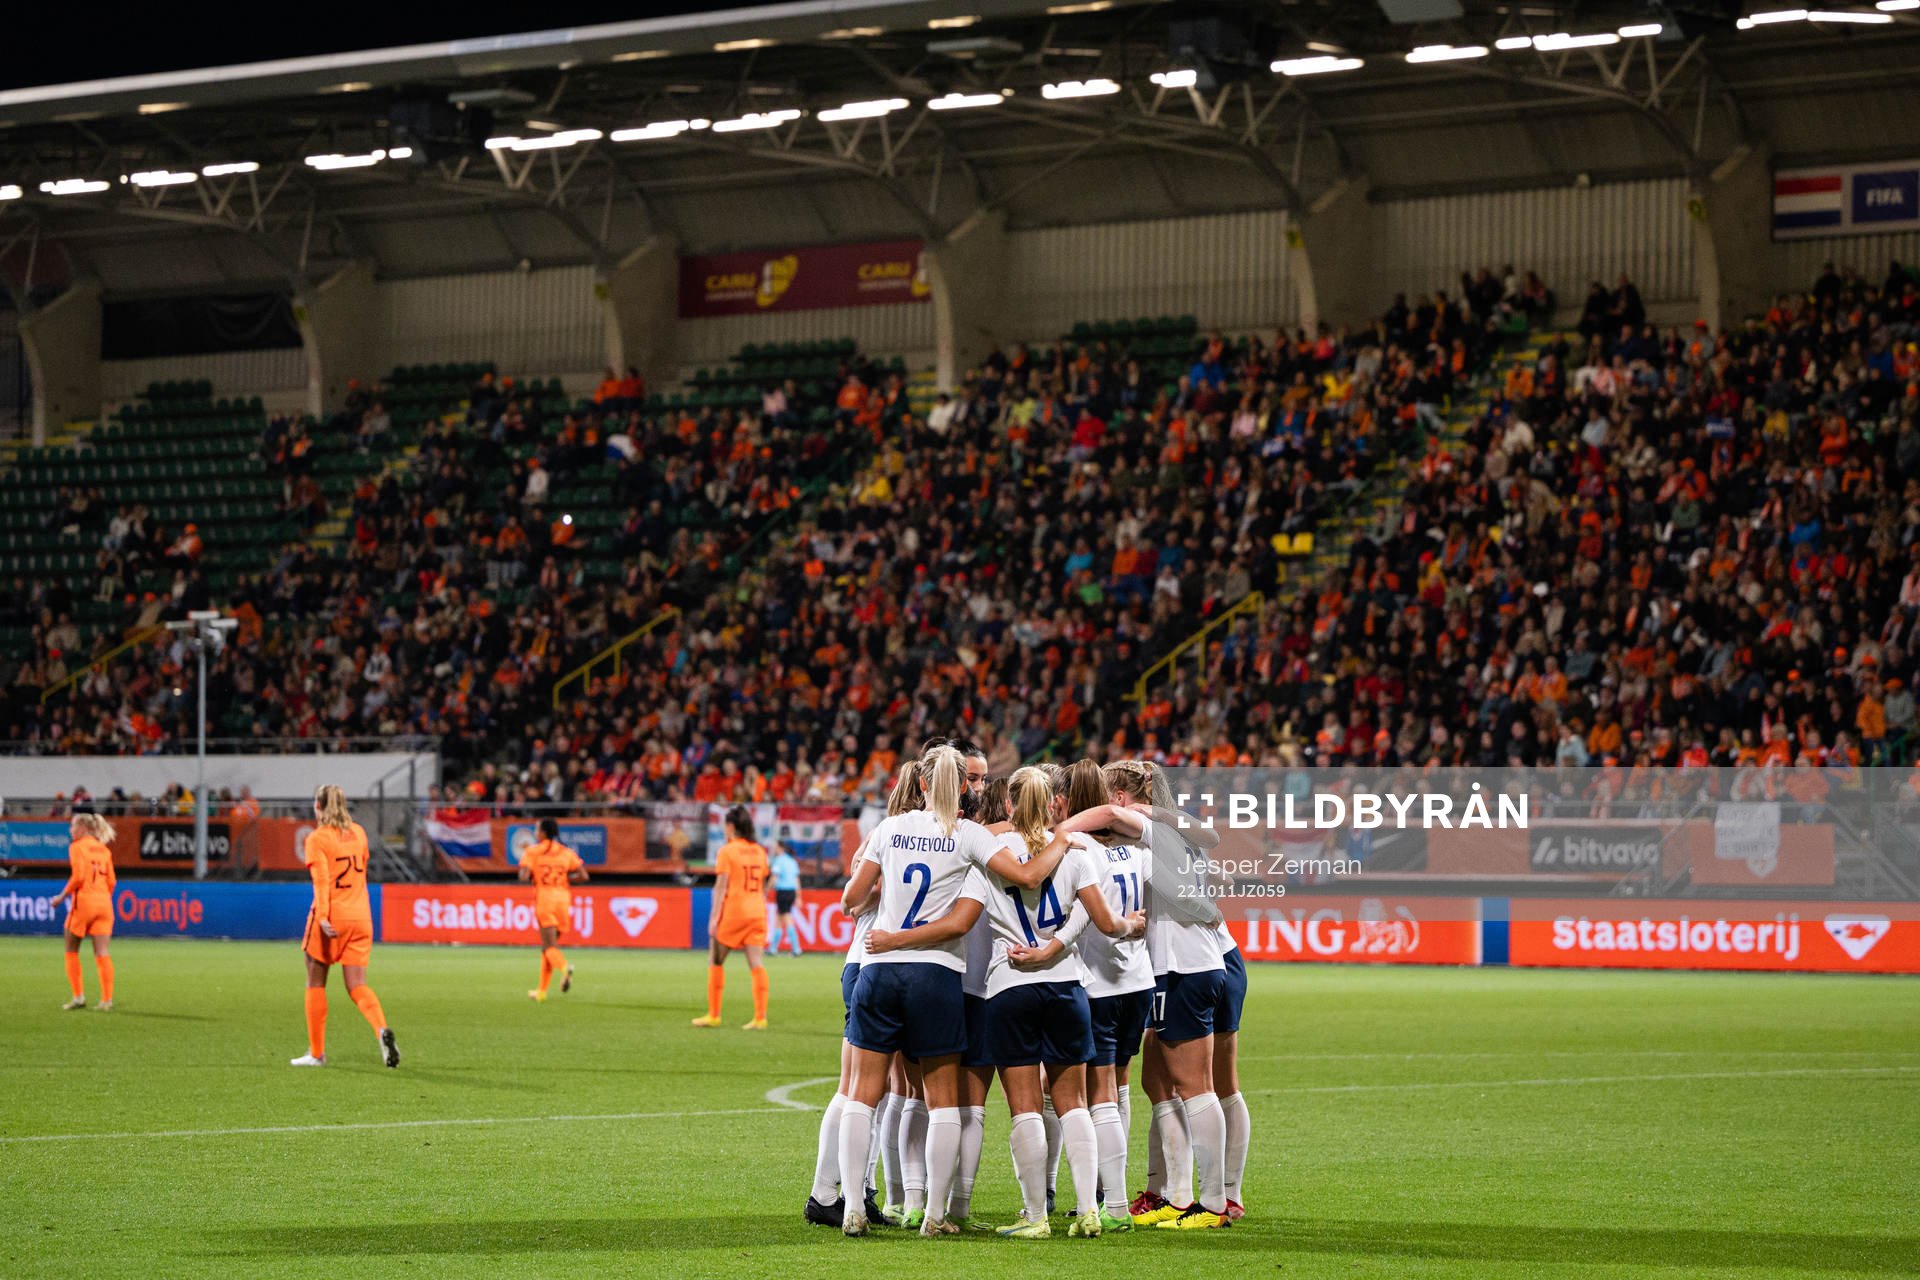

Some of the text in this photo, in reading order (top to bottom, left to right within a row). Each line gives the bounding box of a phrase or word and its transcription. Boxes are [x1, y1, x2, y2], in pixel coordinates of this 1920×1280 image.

[1866, 187, 1904, 207] FIFA
[163, 830, 229, 855] bitvvo
[742, 865, 761, 892] 15
[900, 862, 932, 930] 2
[117, 890, 204, 931] Oranje
[1004, 876, 1067, 949] 14
[1243, 907, 1347, 954] ING
[1552, 913, 1800, 962] Staatsloterij
